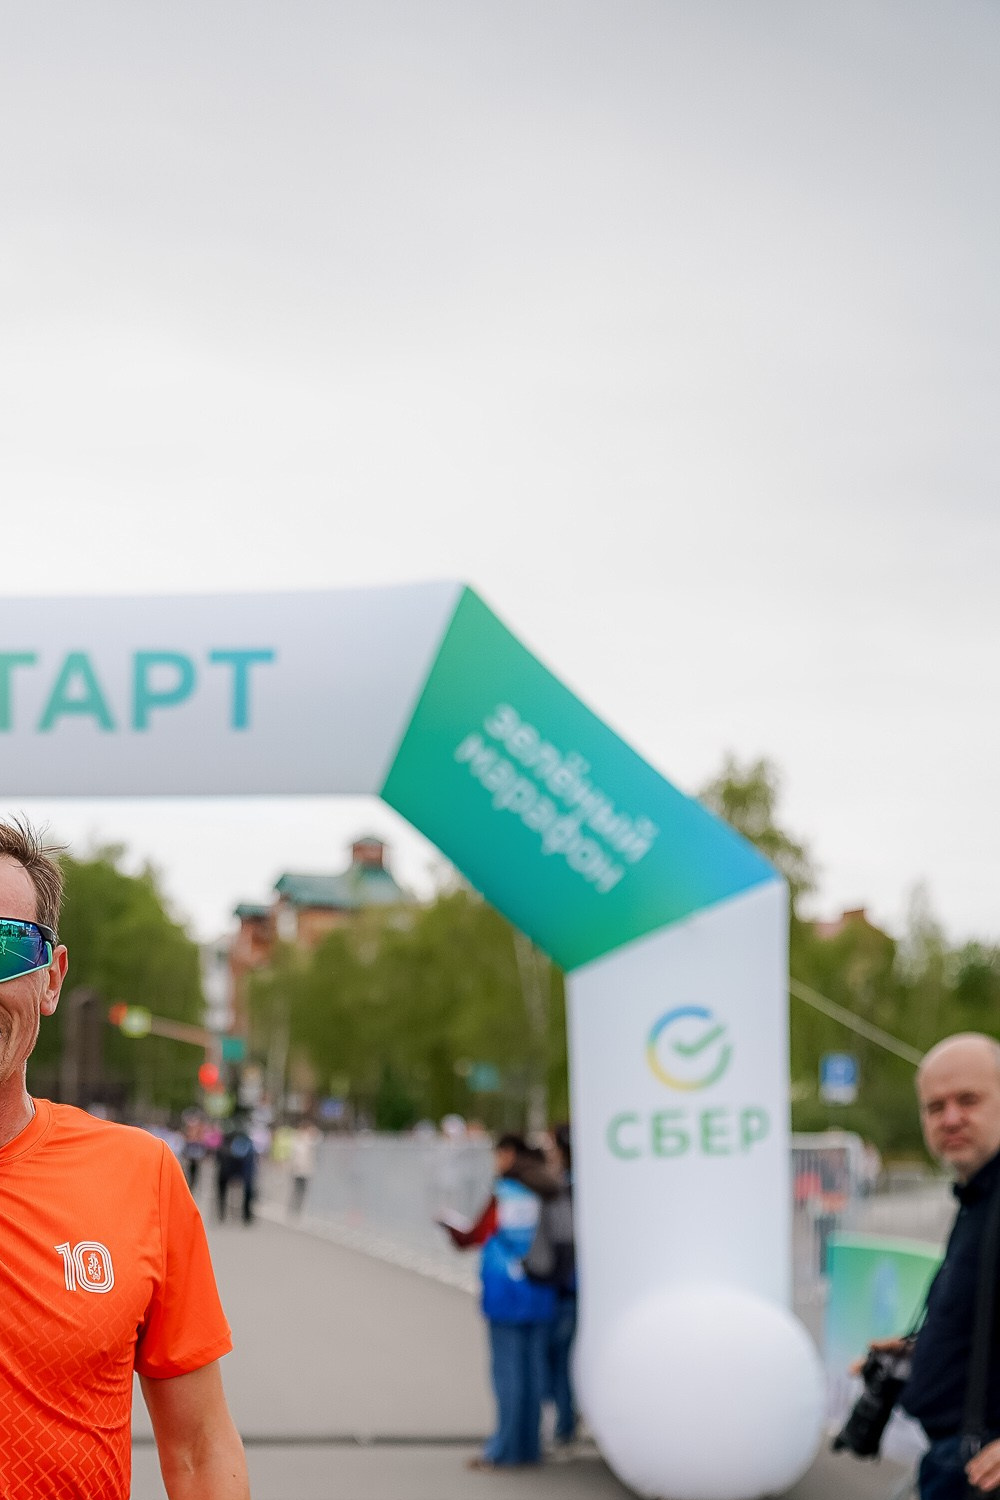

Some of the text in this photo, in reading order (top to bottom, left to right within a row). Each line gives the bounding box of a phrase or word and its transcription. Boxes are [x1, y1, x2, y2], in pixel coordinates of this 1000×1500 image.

[454, 734, 625, 893] марафон
[606, 1106, 771, 1162] СБЕР
[53, 1241, 115, 1294] 10
